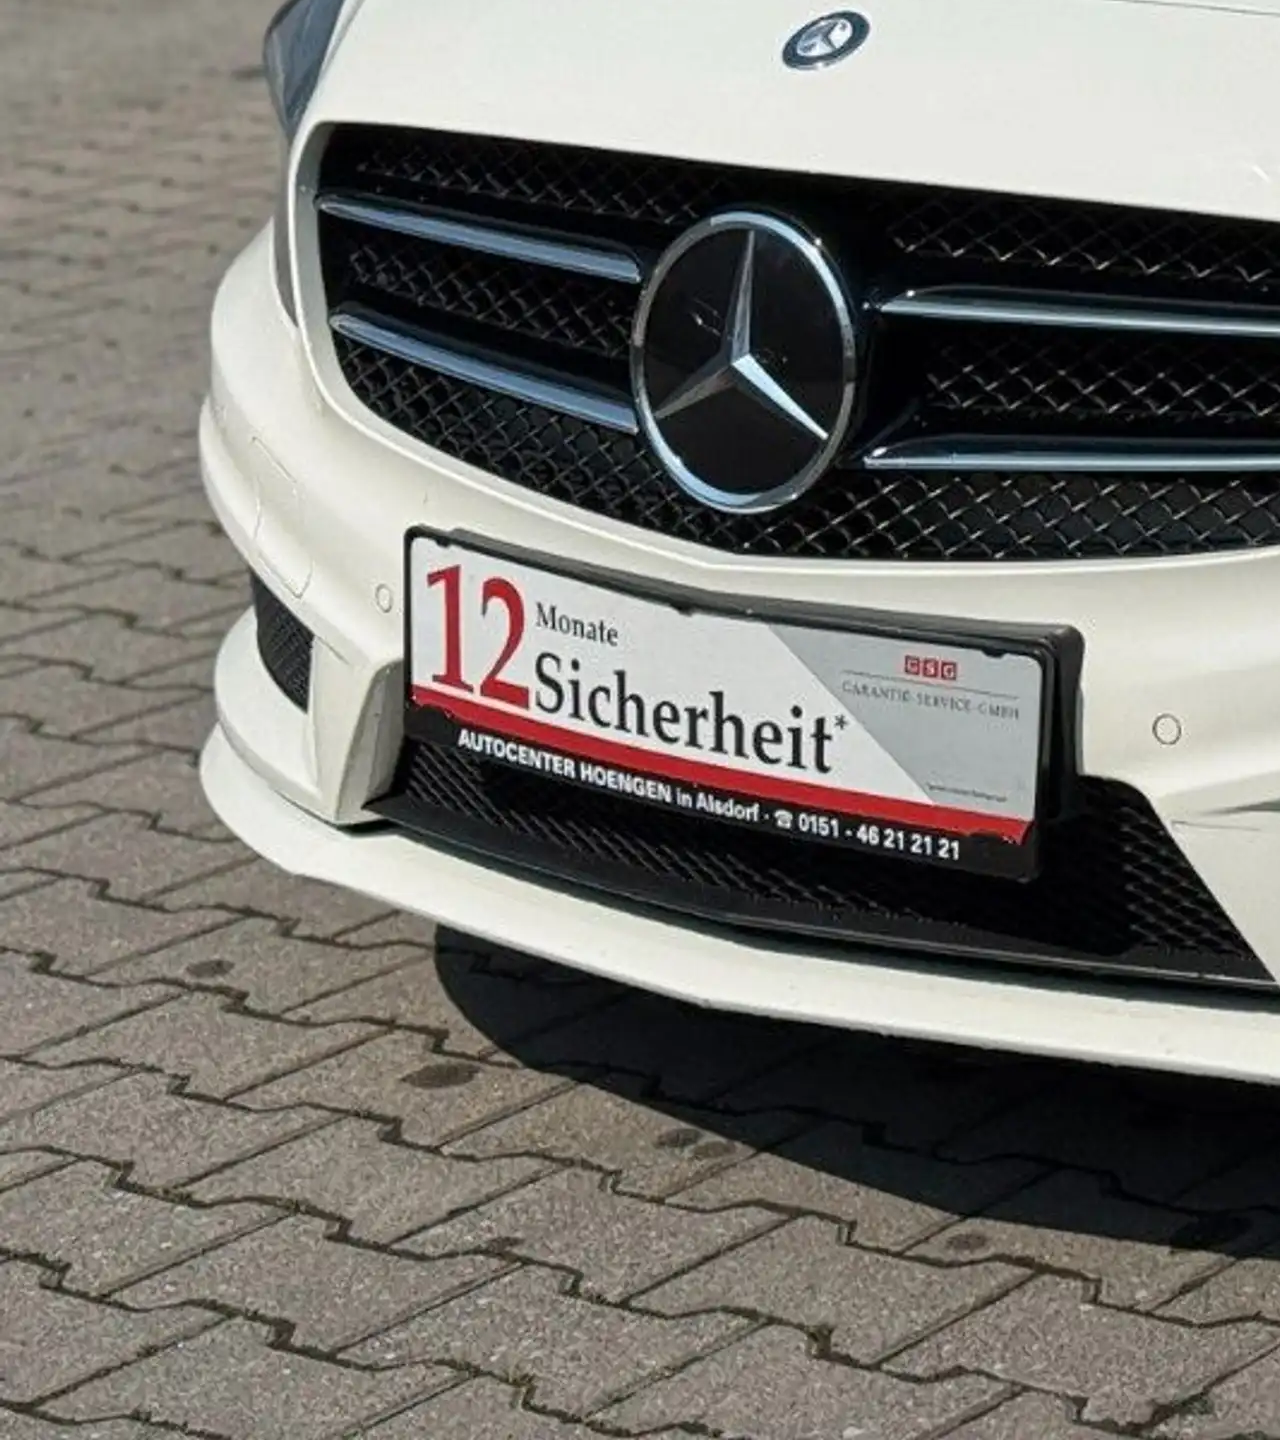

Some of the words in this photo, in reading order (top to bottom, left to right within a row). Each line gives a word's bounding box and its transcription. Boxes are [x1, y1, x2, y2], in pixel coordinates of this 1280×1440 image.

[426, 563, 530, 711] 12
[535, 601, 619, 647] Monate
[457, 728, 576, 779] AUTOCENTER
[580, 761, 673, 804] HOENGEN
[676, 787, 693, 808] in
[696, 792, 760, 822] Alsdorf
[798, 812, 840, 838] 0151
[856, 823, 880, 846] 46
[883, 828, 905, 851] 21
[910, 834, 933, 856] 21
[938, 839, 960, 861] 21
